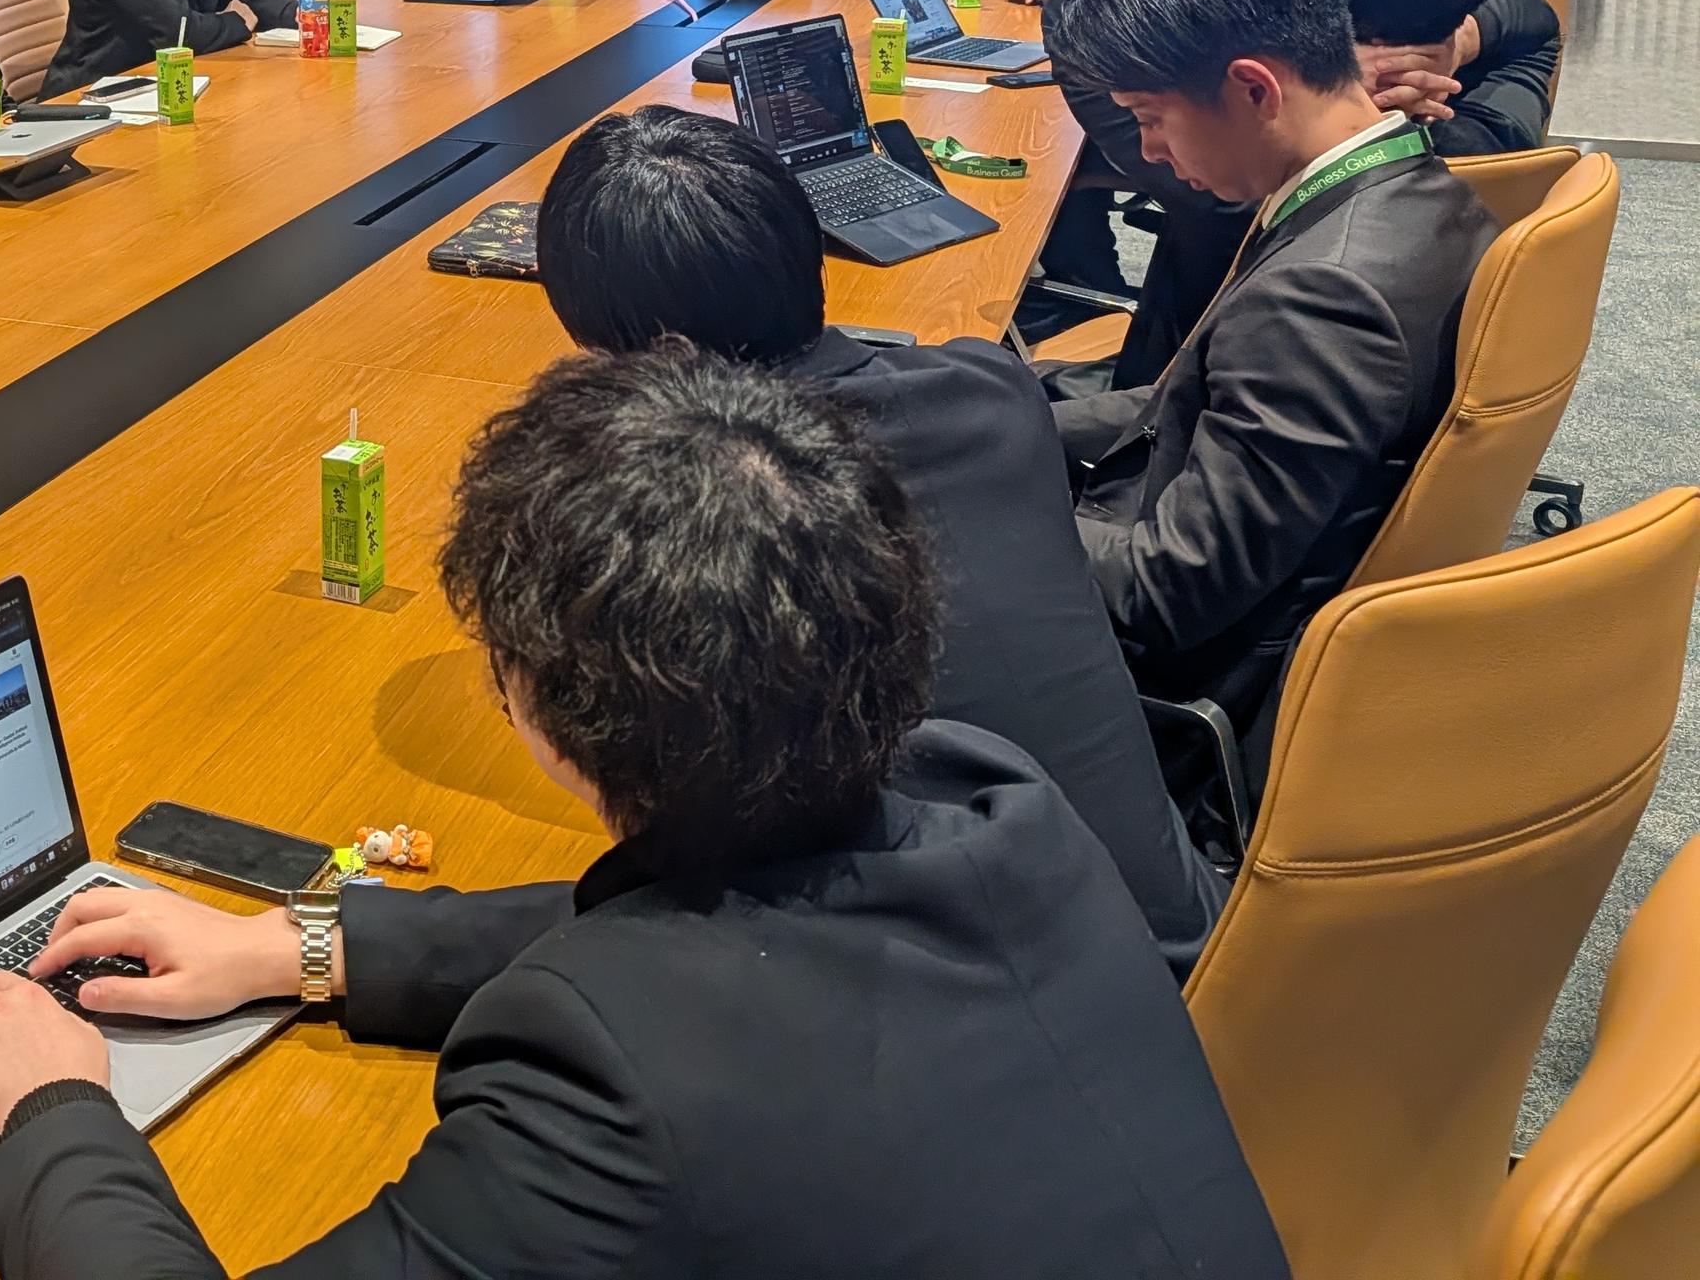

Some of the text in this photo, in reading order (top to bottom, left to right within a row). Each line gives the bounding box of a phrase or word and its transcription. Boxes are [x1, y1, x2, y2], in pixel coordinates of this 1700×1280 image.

[337, 16, 350, 40] お茶
[879, 48, 894, 74] お茶
[176, 79, 188, 104] お茶
[967, 166, 1022, 177] Business Guest
[1297, 149, 1387, 201] Business Guest
